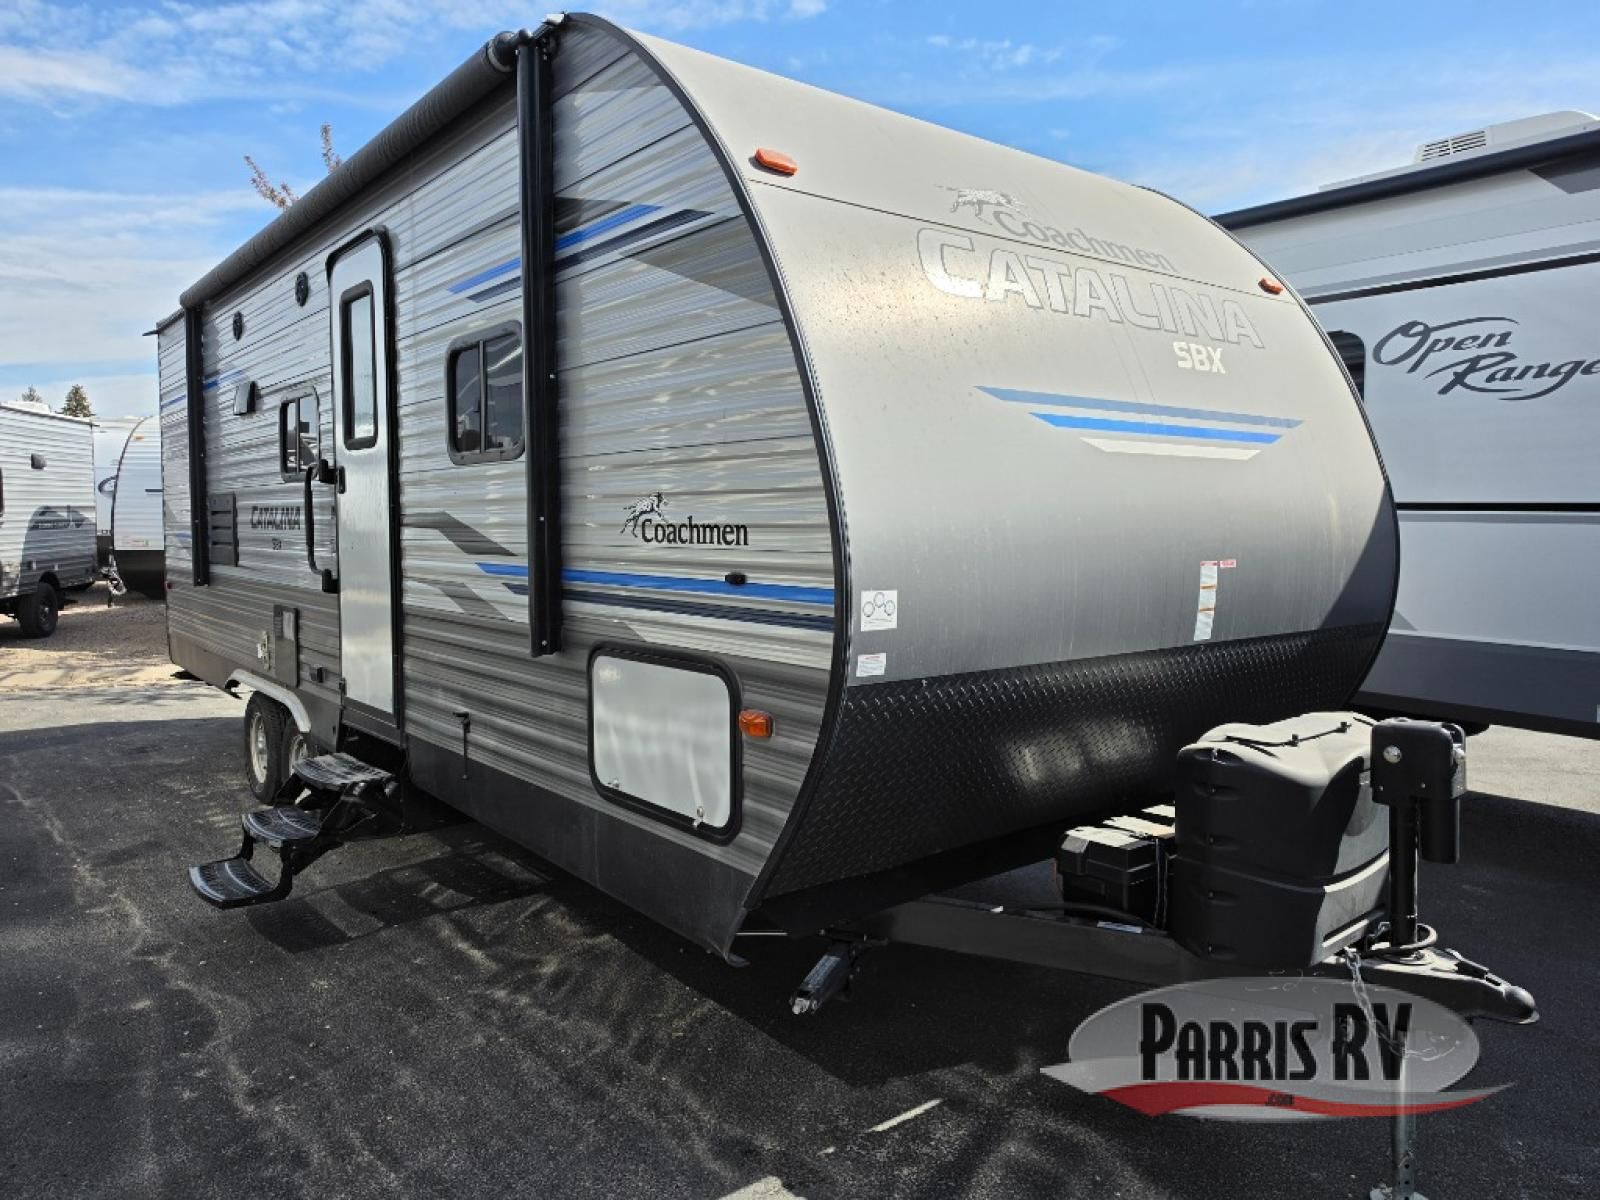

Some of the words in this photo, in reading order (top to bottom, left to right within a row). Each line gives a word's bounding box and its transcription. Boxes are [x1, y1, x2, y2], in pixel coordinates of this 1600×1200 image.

[993, 211, 1177, 272] Coachmen
[916, 227, 1265, 348] CATALINA
[1173, 342, 1226, 374] SBX
[1373, 317, 1520, 374] Open
[1424, 352, 1600, 400] Range
[641, 515, 749, 546] Coachmen
